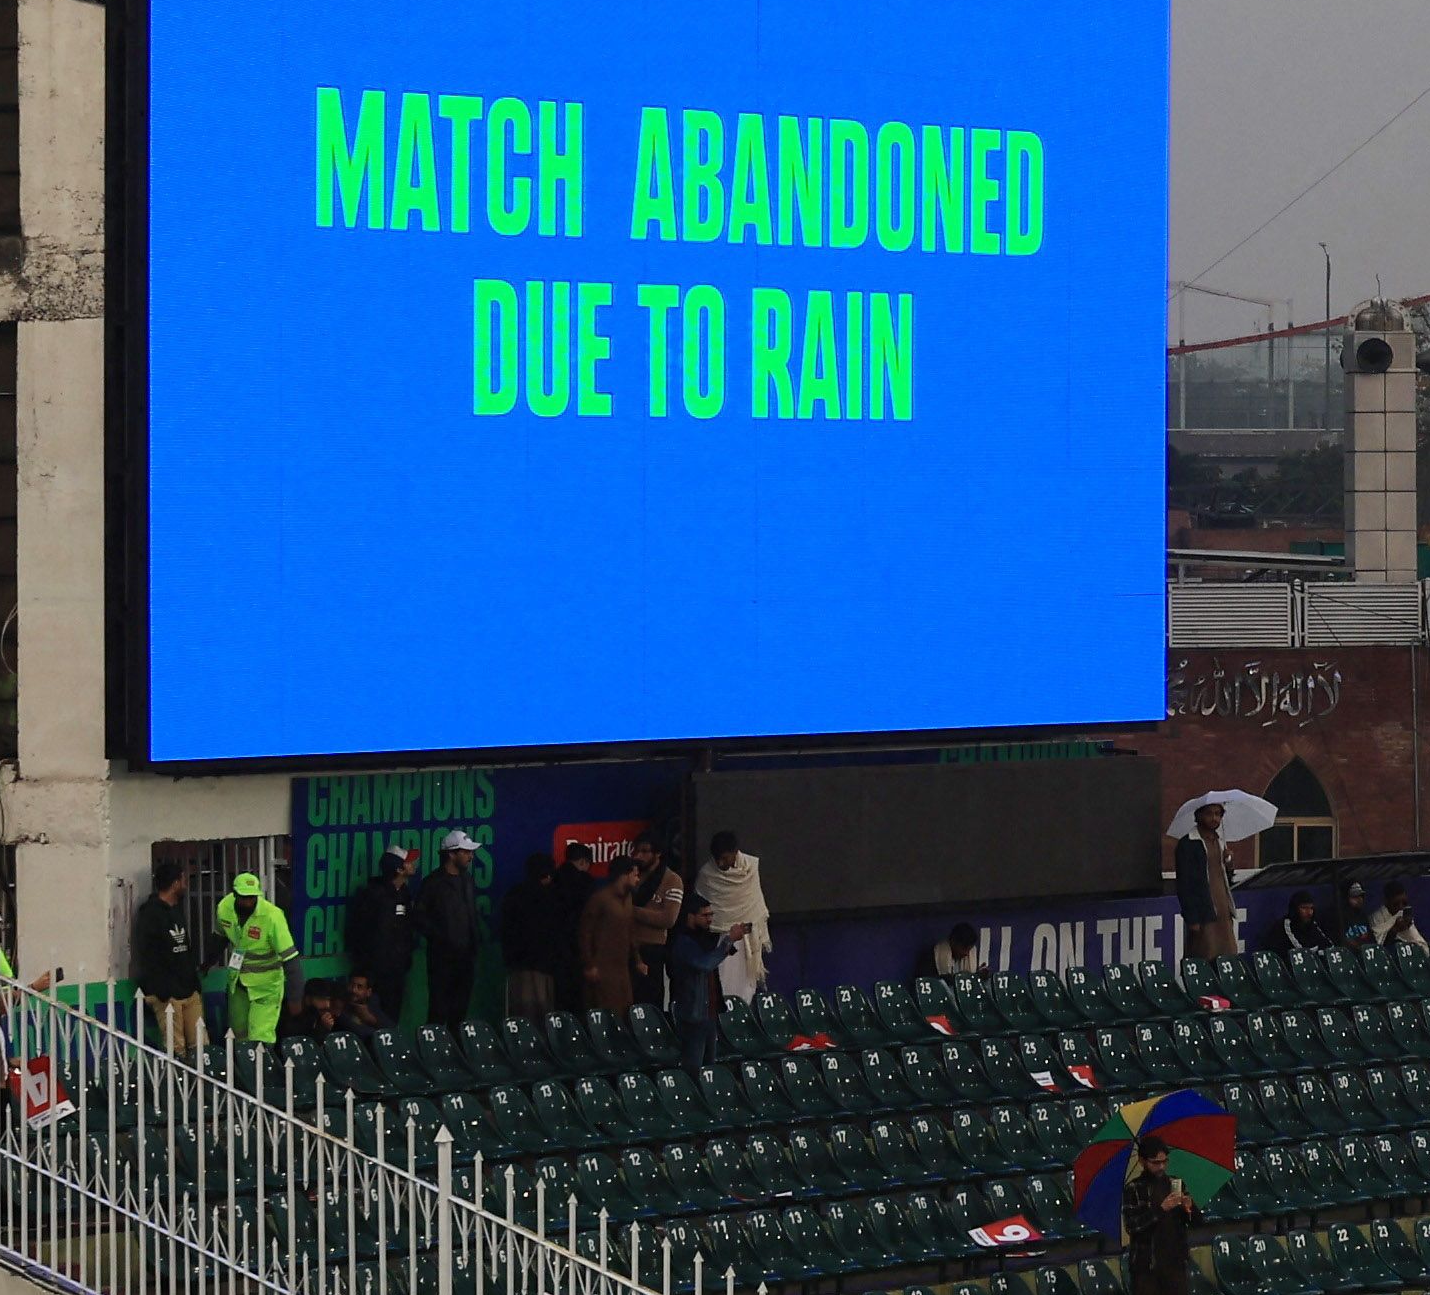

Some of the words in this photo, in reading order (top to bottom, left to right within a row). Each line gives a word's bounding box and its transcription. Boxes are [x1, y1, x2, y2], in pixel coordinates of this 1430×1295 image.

[320, 89, 580, 235] MATCH
[634, 109, 1041, 254] ABANDONED
[477, 281, 609, 415] DUE
[641, 286, 722, 417] TO
[755, 290, 910, 419] RAIN
[308, 770, 495, 827] CHAMPIONS
[1097, 915, 1163, 971] THE
[629, 1153, 641, 1165] 12
